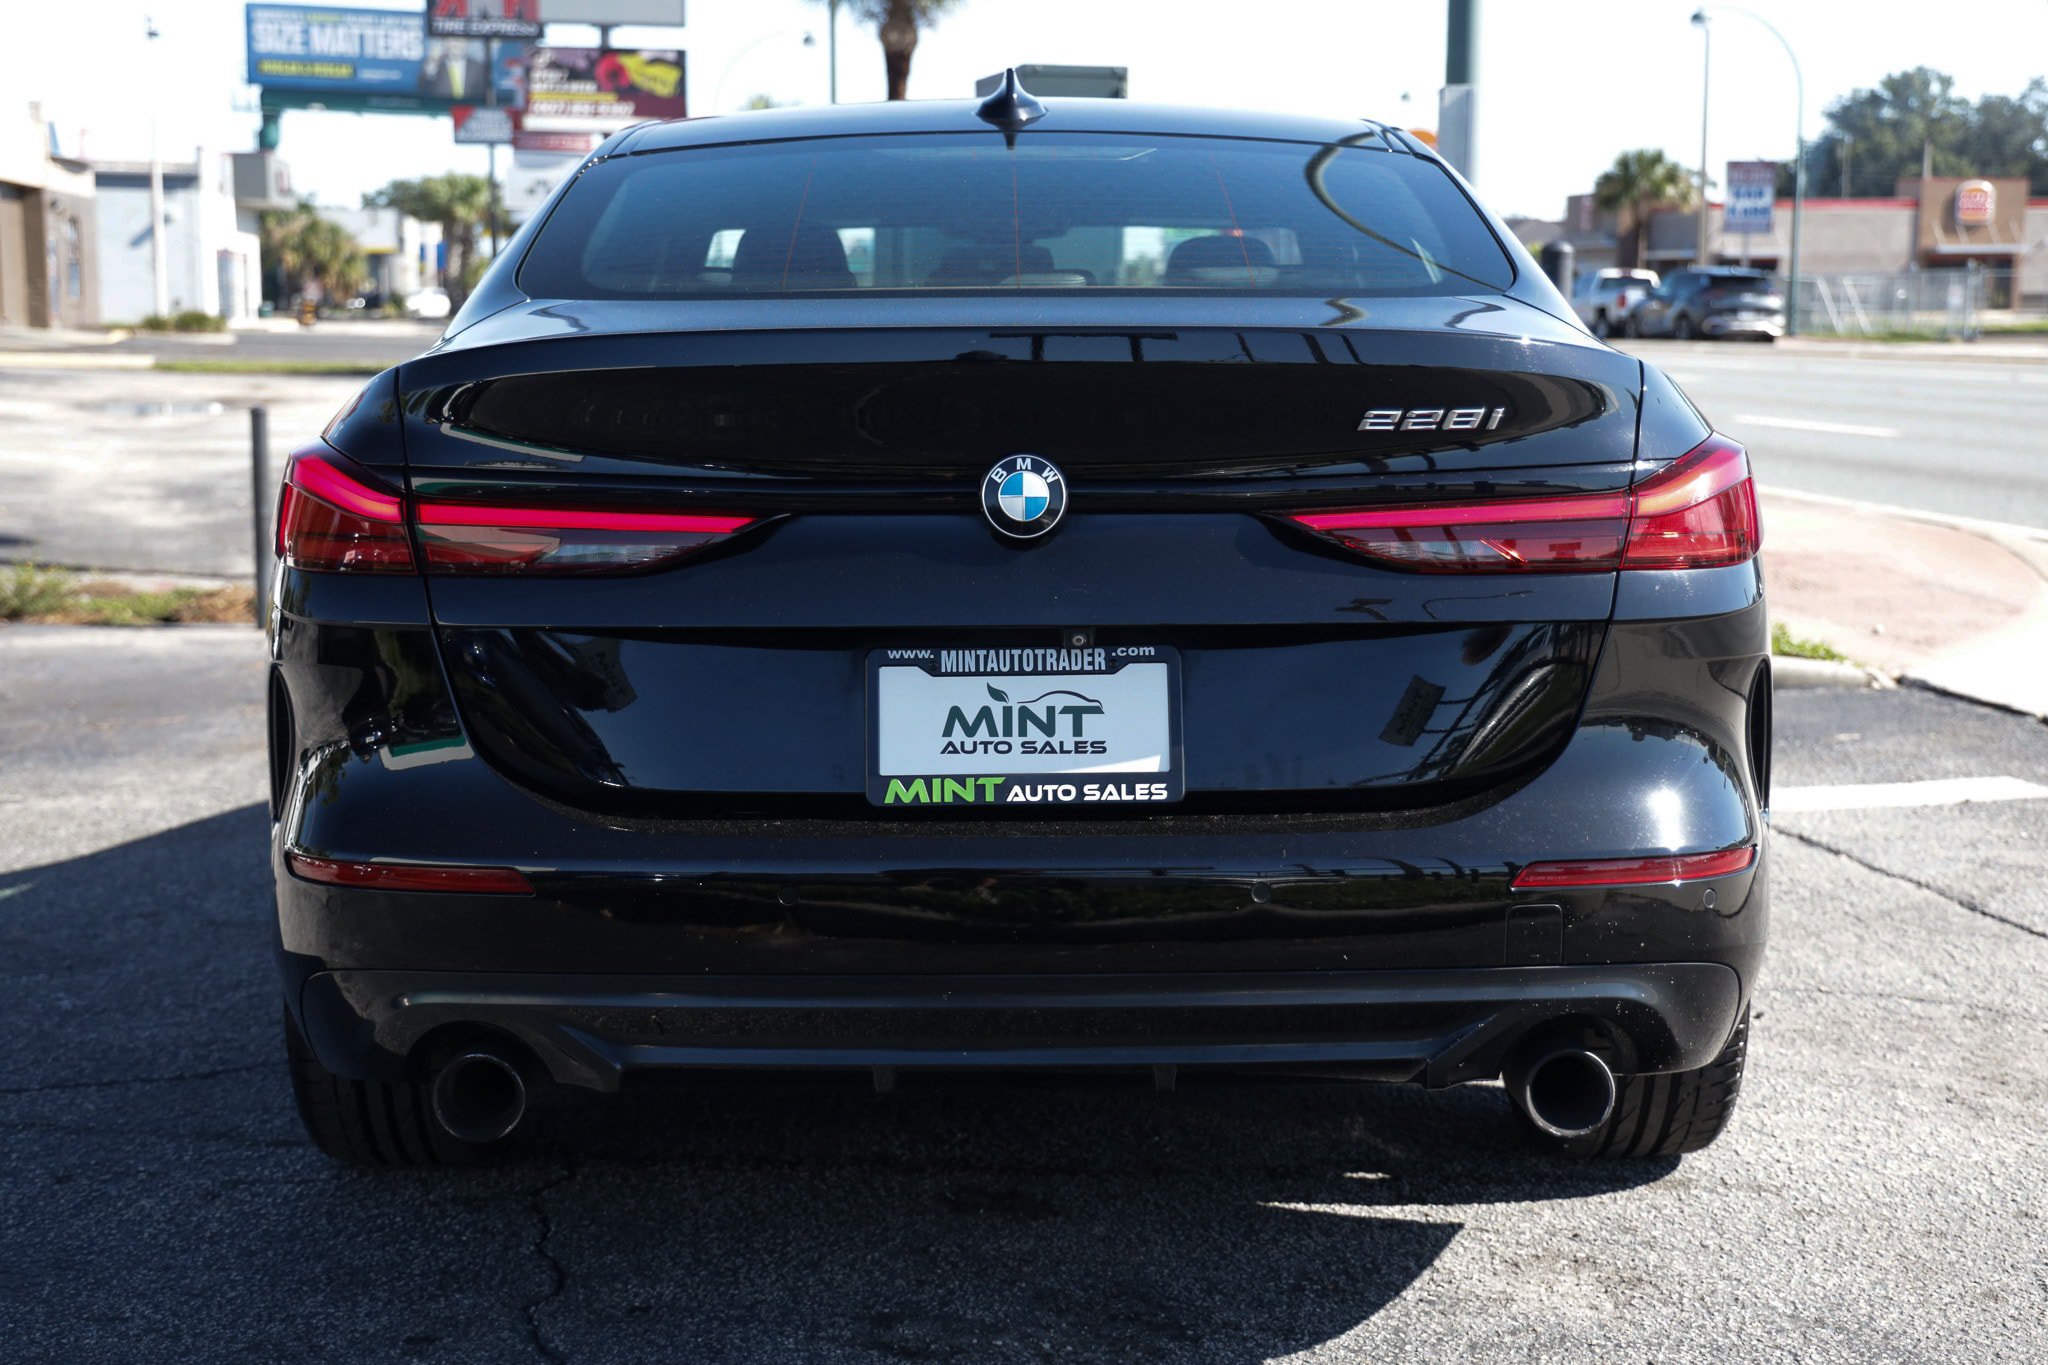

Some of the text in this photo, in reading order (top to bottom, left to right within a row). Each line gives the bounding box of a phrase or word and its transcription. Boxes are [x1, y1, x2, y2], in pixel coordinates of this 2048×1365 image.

[253, 22, 425, 60] SIZE MATTERS
[1357, 407, 1505, 431] 228i
[991, 457, 1059, 484] BMW
[887, 645, 1155, 673] www. MINTAUTOTRADER .com
[941, 704, 1106, 738] MINT
[940, 740, 1107, 755] AUTO SALES
[884, 776, 1168, 803] MINT AUTO SALES
